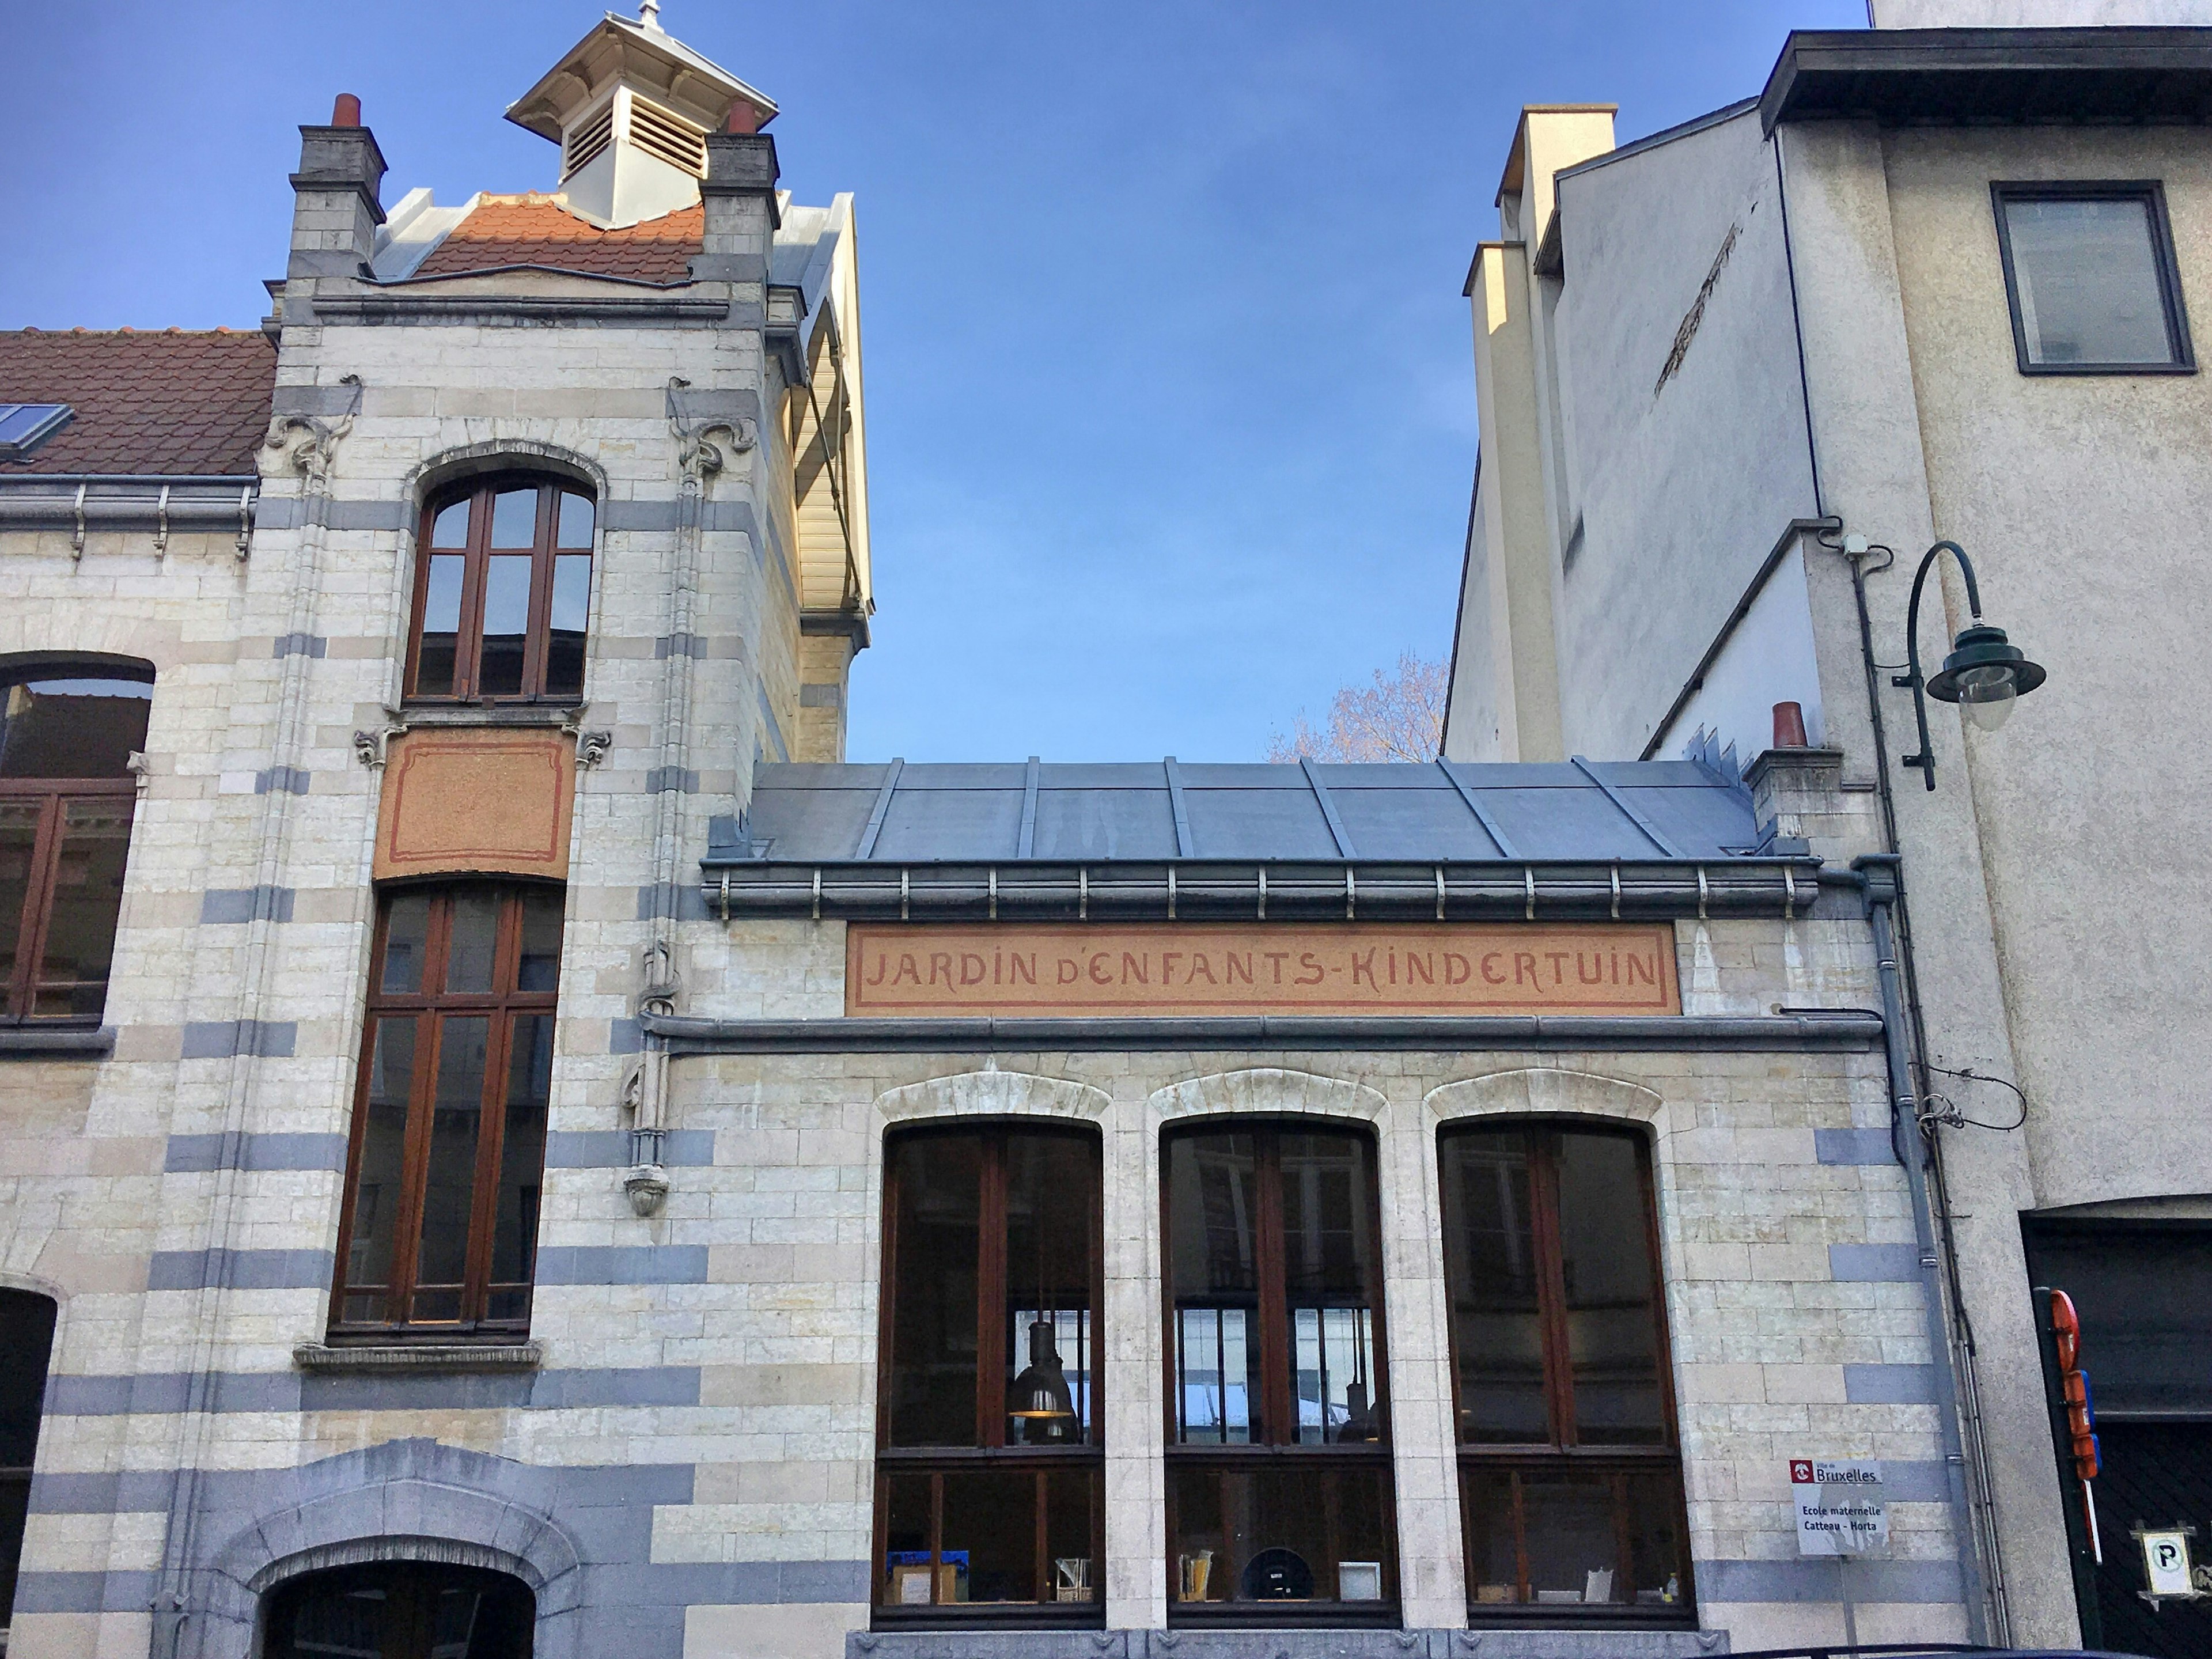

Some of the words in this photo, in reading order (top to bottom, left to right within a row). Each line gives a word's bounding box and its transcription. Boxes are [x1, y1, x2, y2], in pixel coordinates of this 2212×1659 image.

[1817, 1468, 1876, 1482] Bruxelles
[1802, 1506, 1827, 1516] Ecole
[1831, 1506, 1881, 1516] maternelle
[1804, 1521, 1840, 1531] Catteau
[1850, 1521, 1877, 1531] Horta
[2158, 1544, 2176, 1567] P
